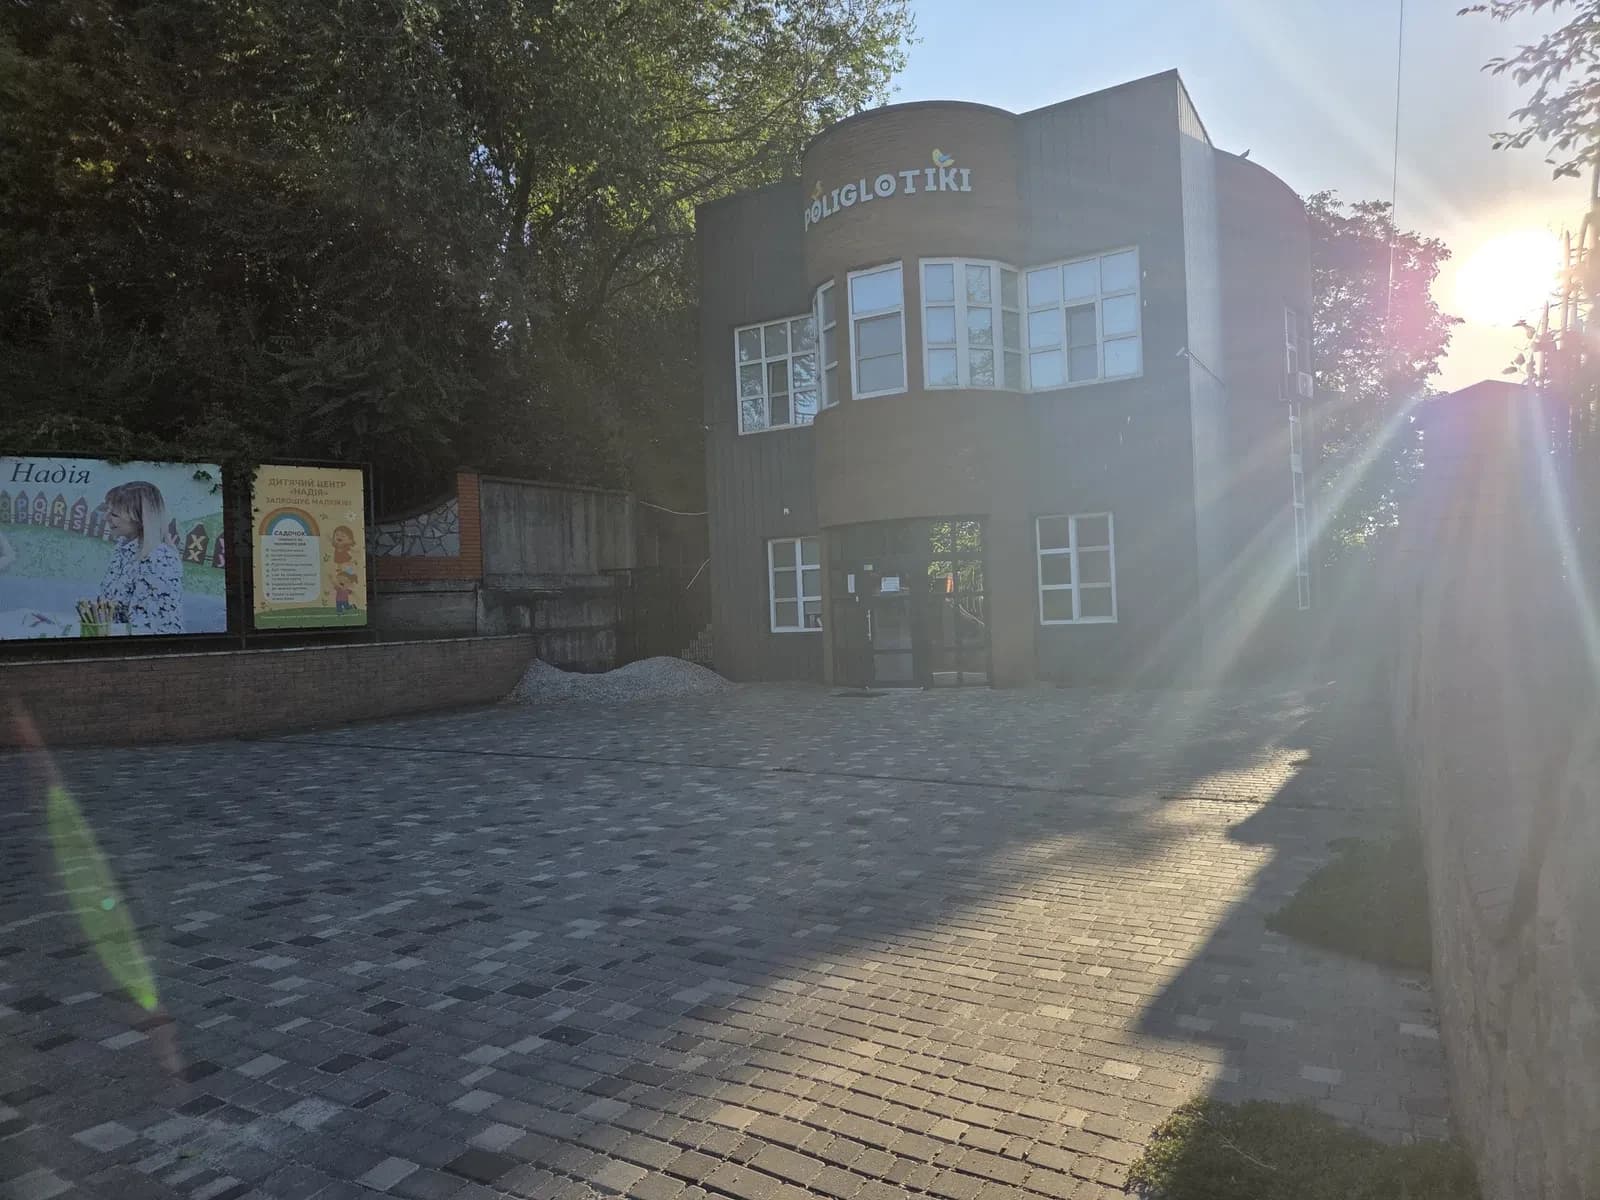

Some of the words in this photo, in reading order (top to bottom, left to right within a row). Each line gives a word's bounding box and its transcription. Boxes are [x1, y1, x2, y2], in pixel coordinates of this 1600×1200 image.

[804, 168, 973, 232] POLIGLOTIKI
[10, 462, 91, 484] Надія
[268, 478, 313, 487] ДИТЯЧИЙ
[317, 480, 346, 488] ЦЕНТР
[54, 501, 64, 514] R
[74, 505, 86, 518] S
[188, 534, 206, 550] X
